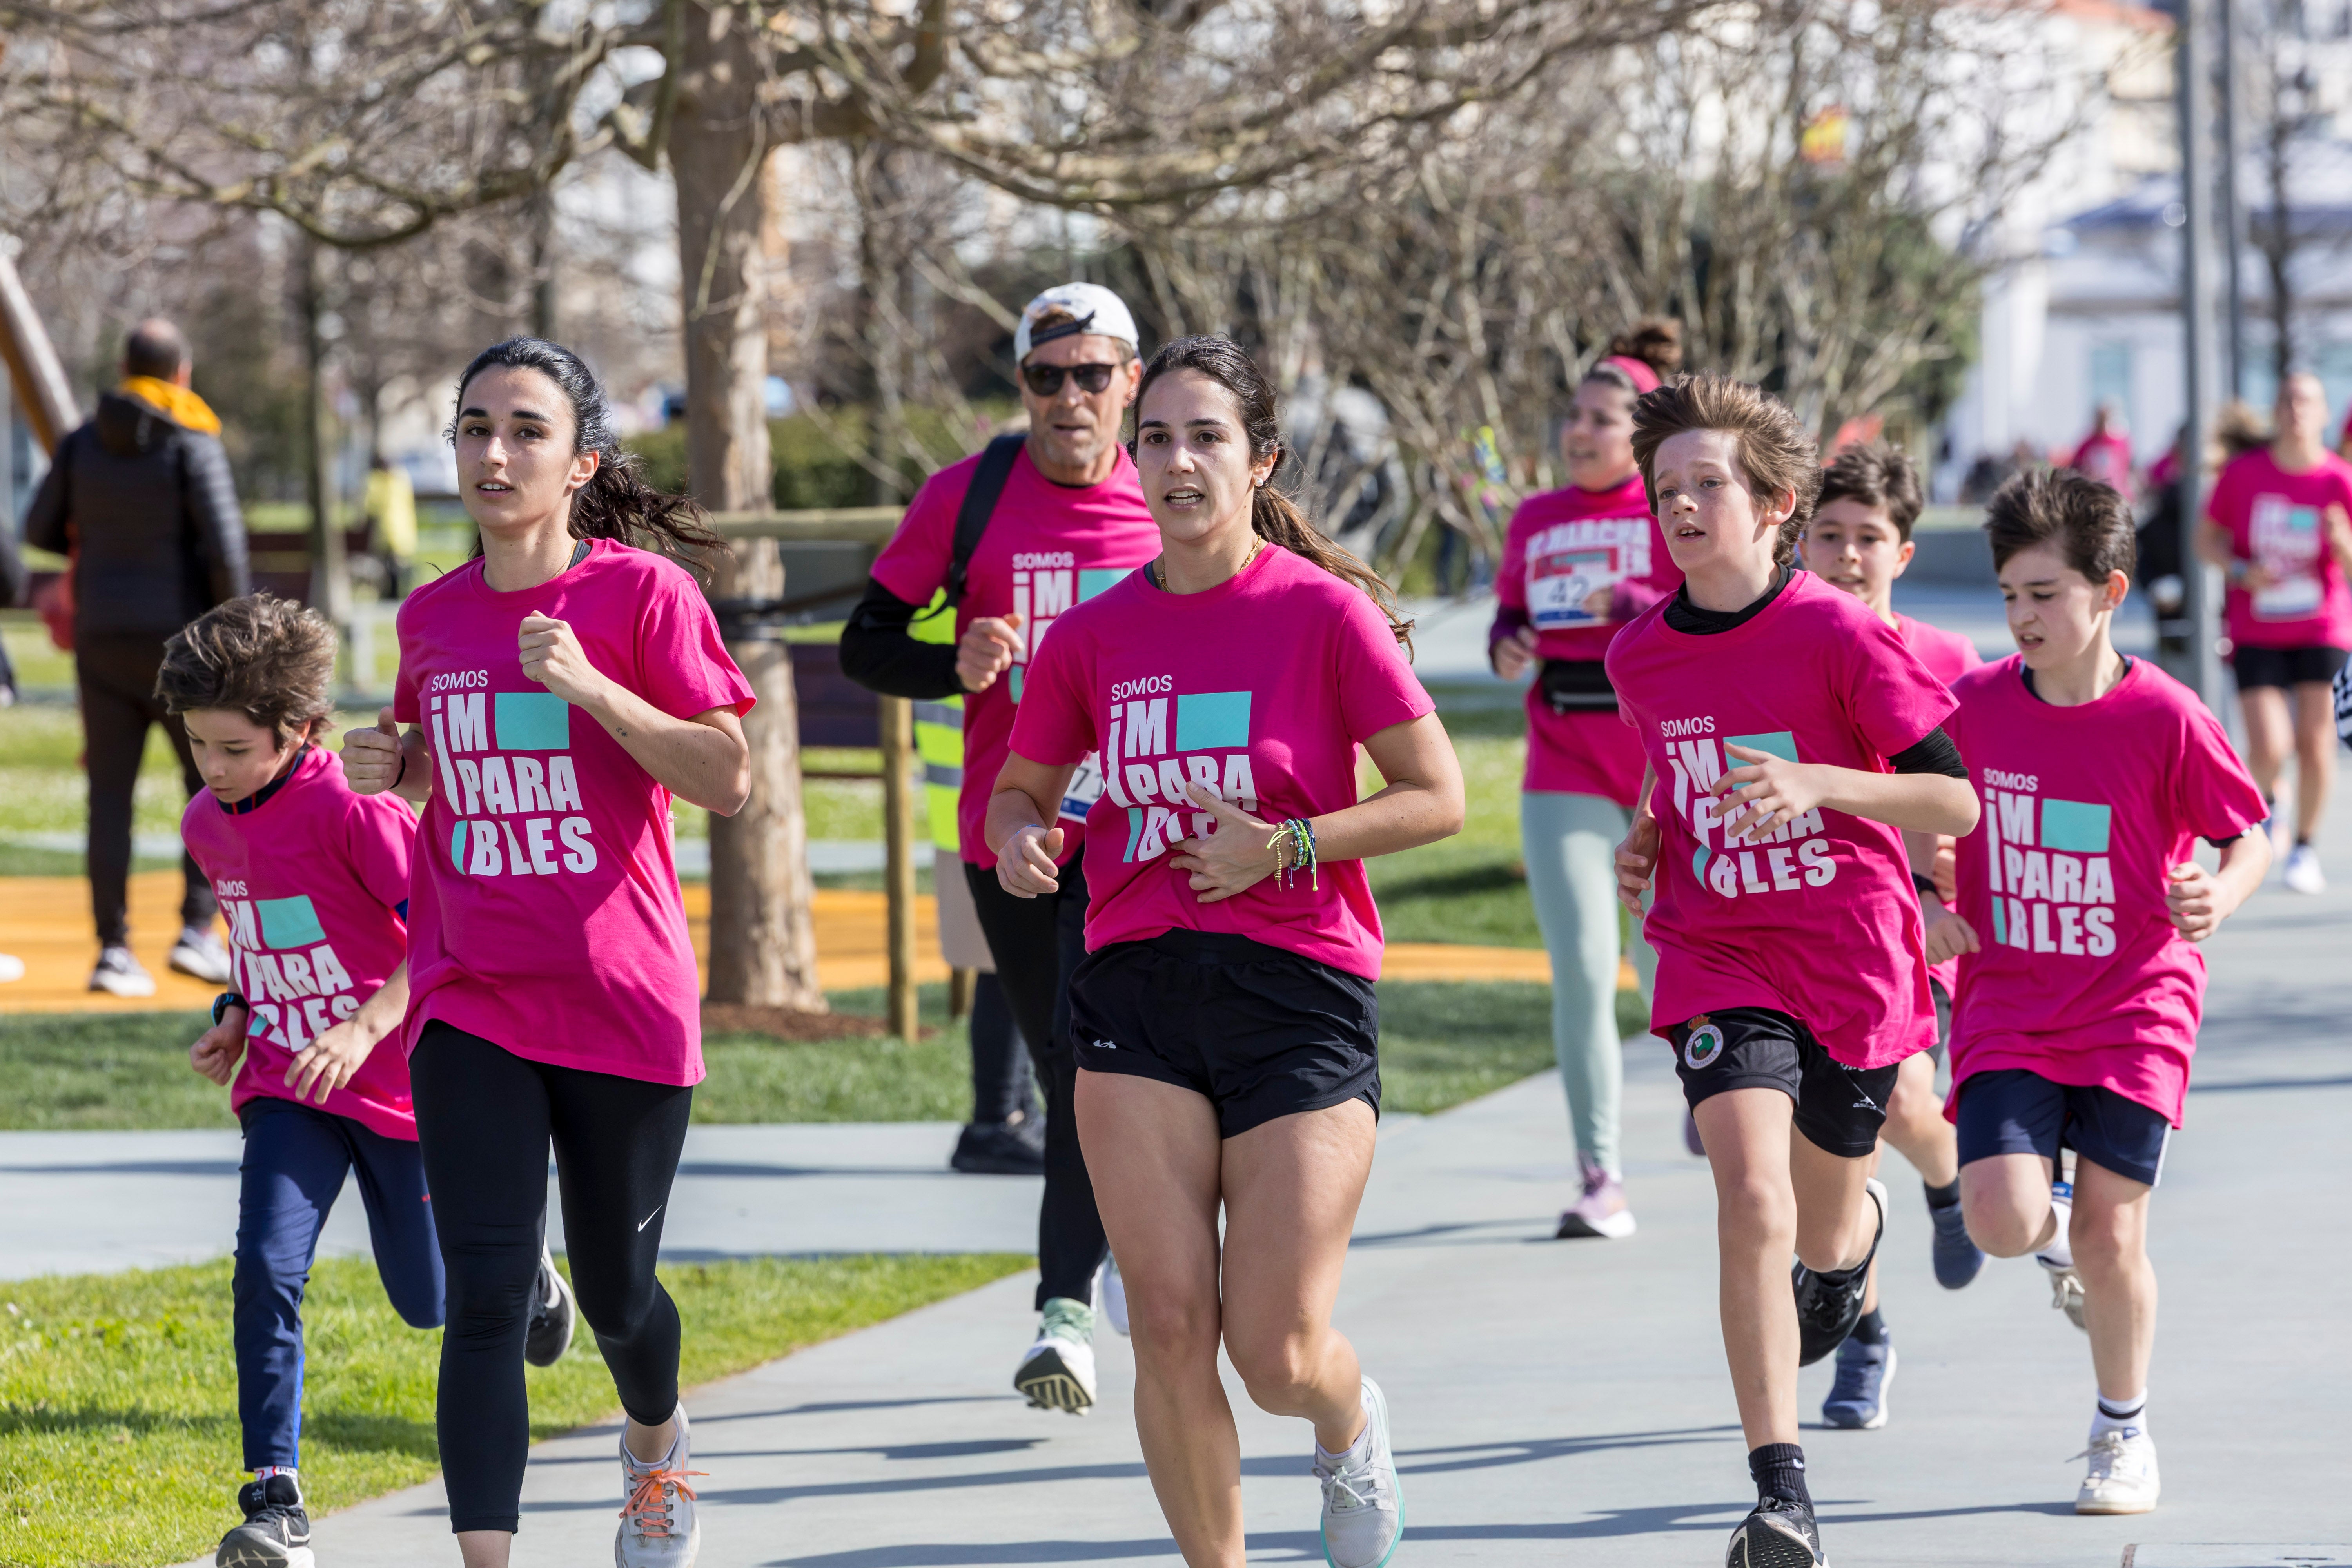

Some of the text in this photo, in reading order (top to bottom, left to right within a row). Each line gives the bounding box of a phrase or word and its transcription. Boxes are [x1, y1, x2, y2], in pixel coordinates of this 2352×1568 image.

[1012, 552, 1074, 570] SOMOS
[431, 670, 488, 691] SOMOS
[1112, 675, 1172, 701] SOMOS
[1661, 716, 1715, 737] SOMOS
[456, 757, 583, 815] PARA
[1983, 768, 2038, 793] SOMOS
[2004, 844, 2116, 904] PARA
[243, 944, 354, 1004] PARA
